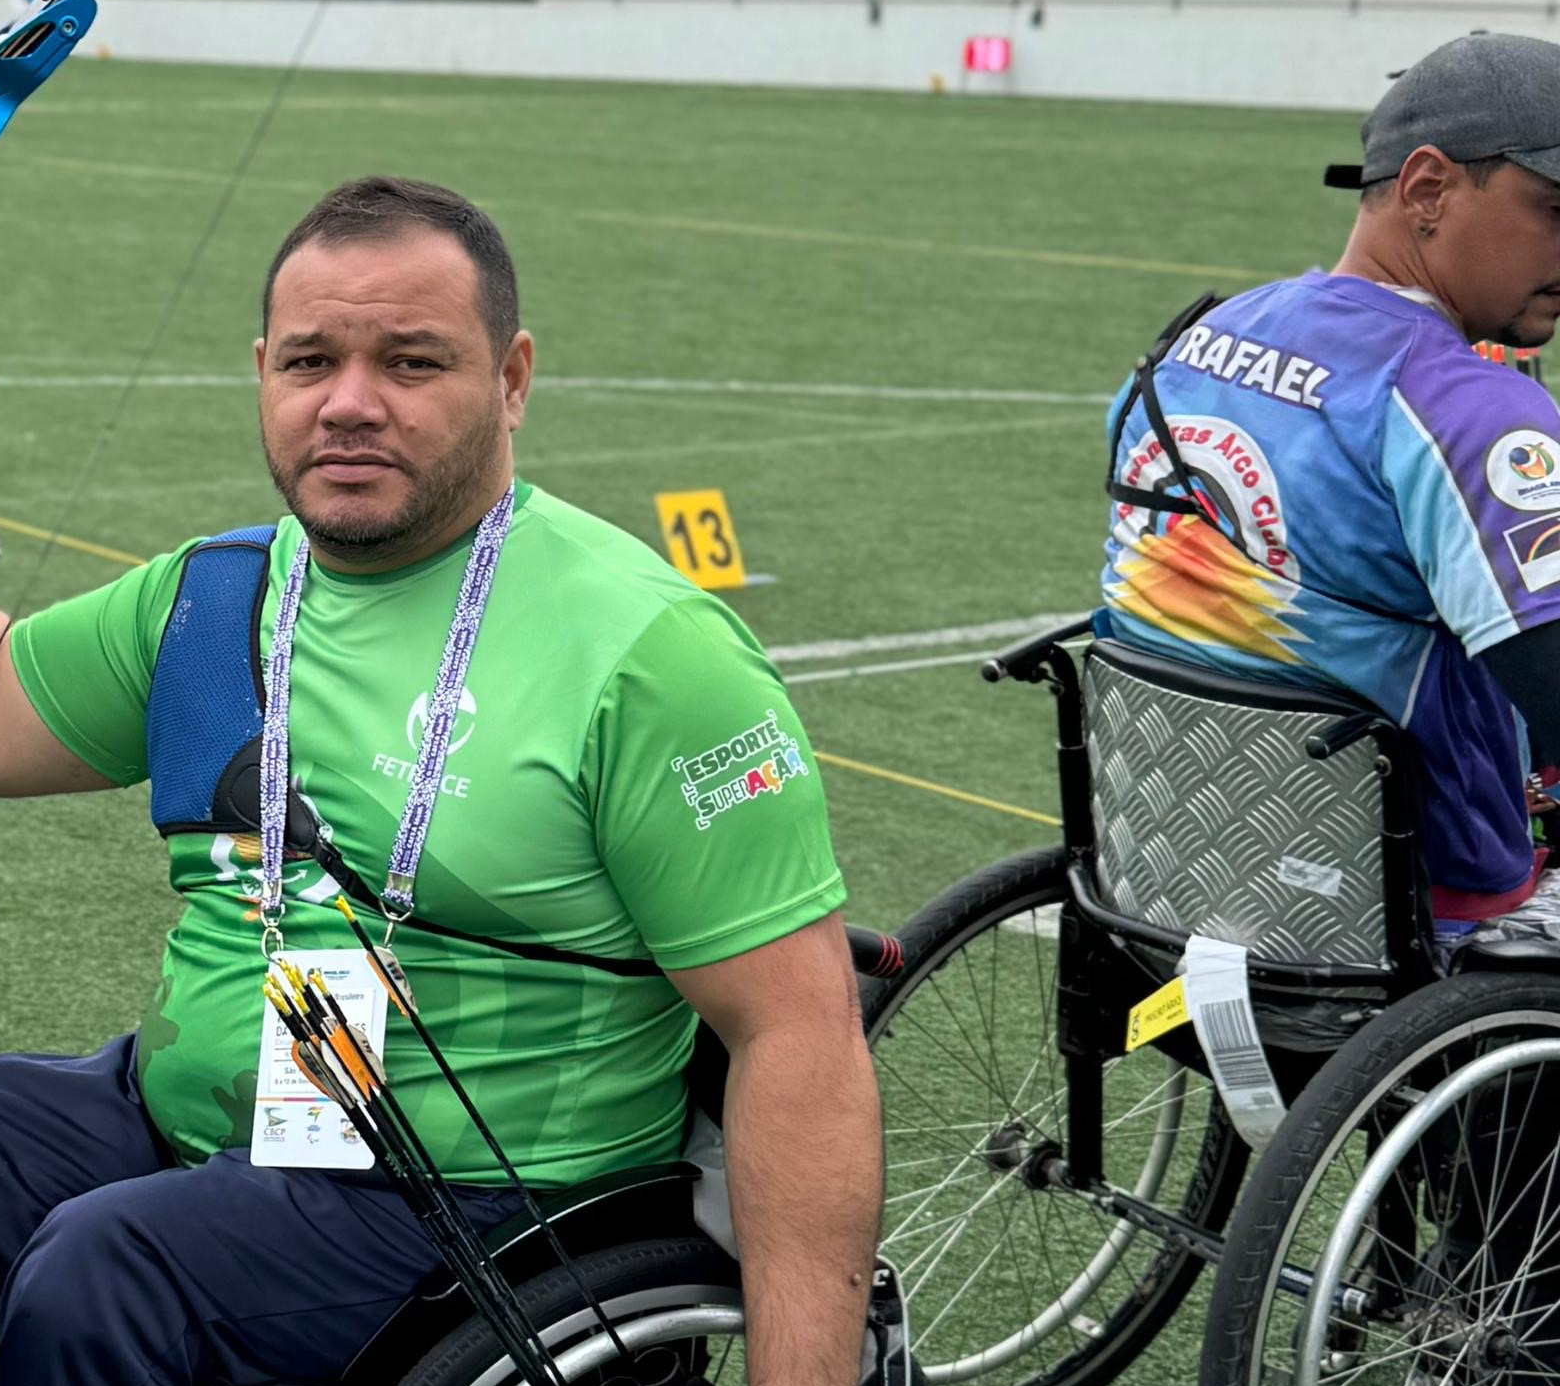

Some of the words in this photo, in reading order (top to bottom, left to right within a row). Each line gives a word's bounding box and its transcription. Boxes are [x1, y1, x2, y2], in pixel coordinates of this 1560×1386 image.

[1176, 326, 1331, 409] RAFAEL
[1214, 432, 1260, 489] Arco
[673, 510, 732, 570] 13
[372, 753, 471, 798] FETCE
[684, 720, 781, 784] ESPORTE
[696, 746, 801, 817] SUPERAÇÃO
